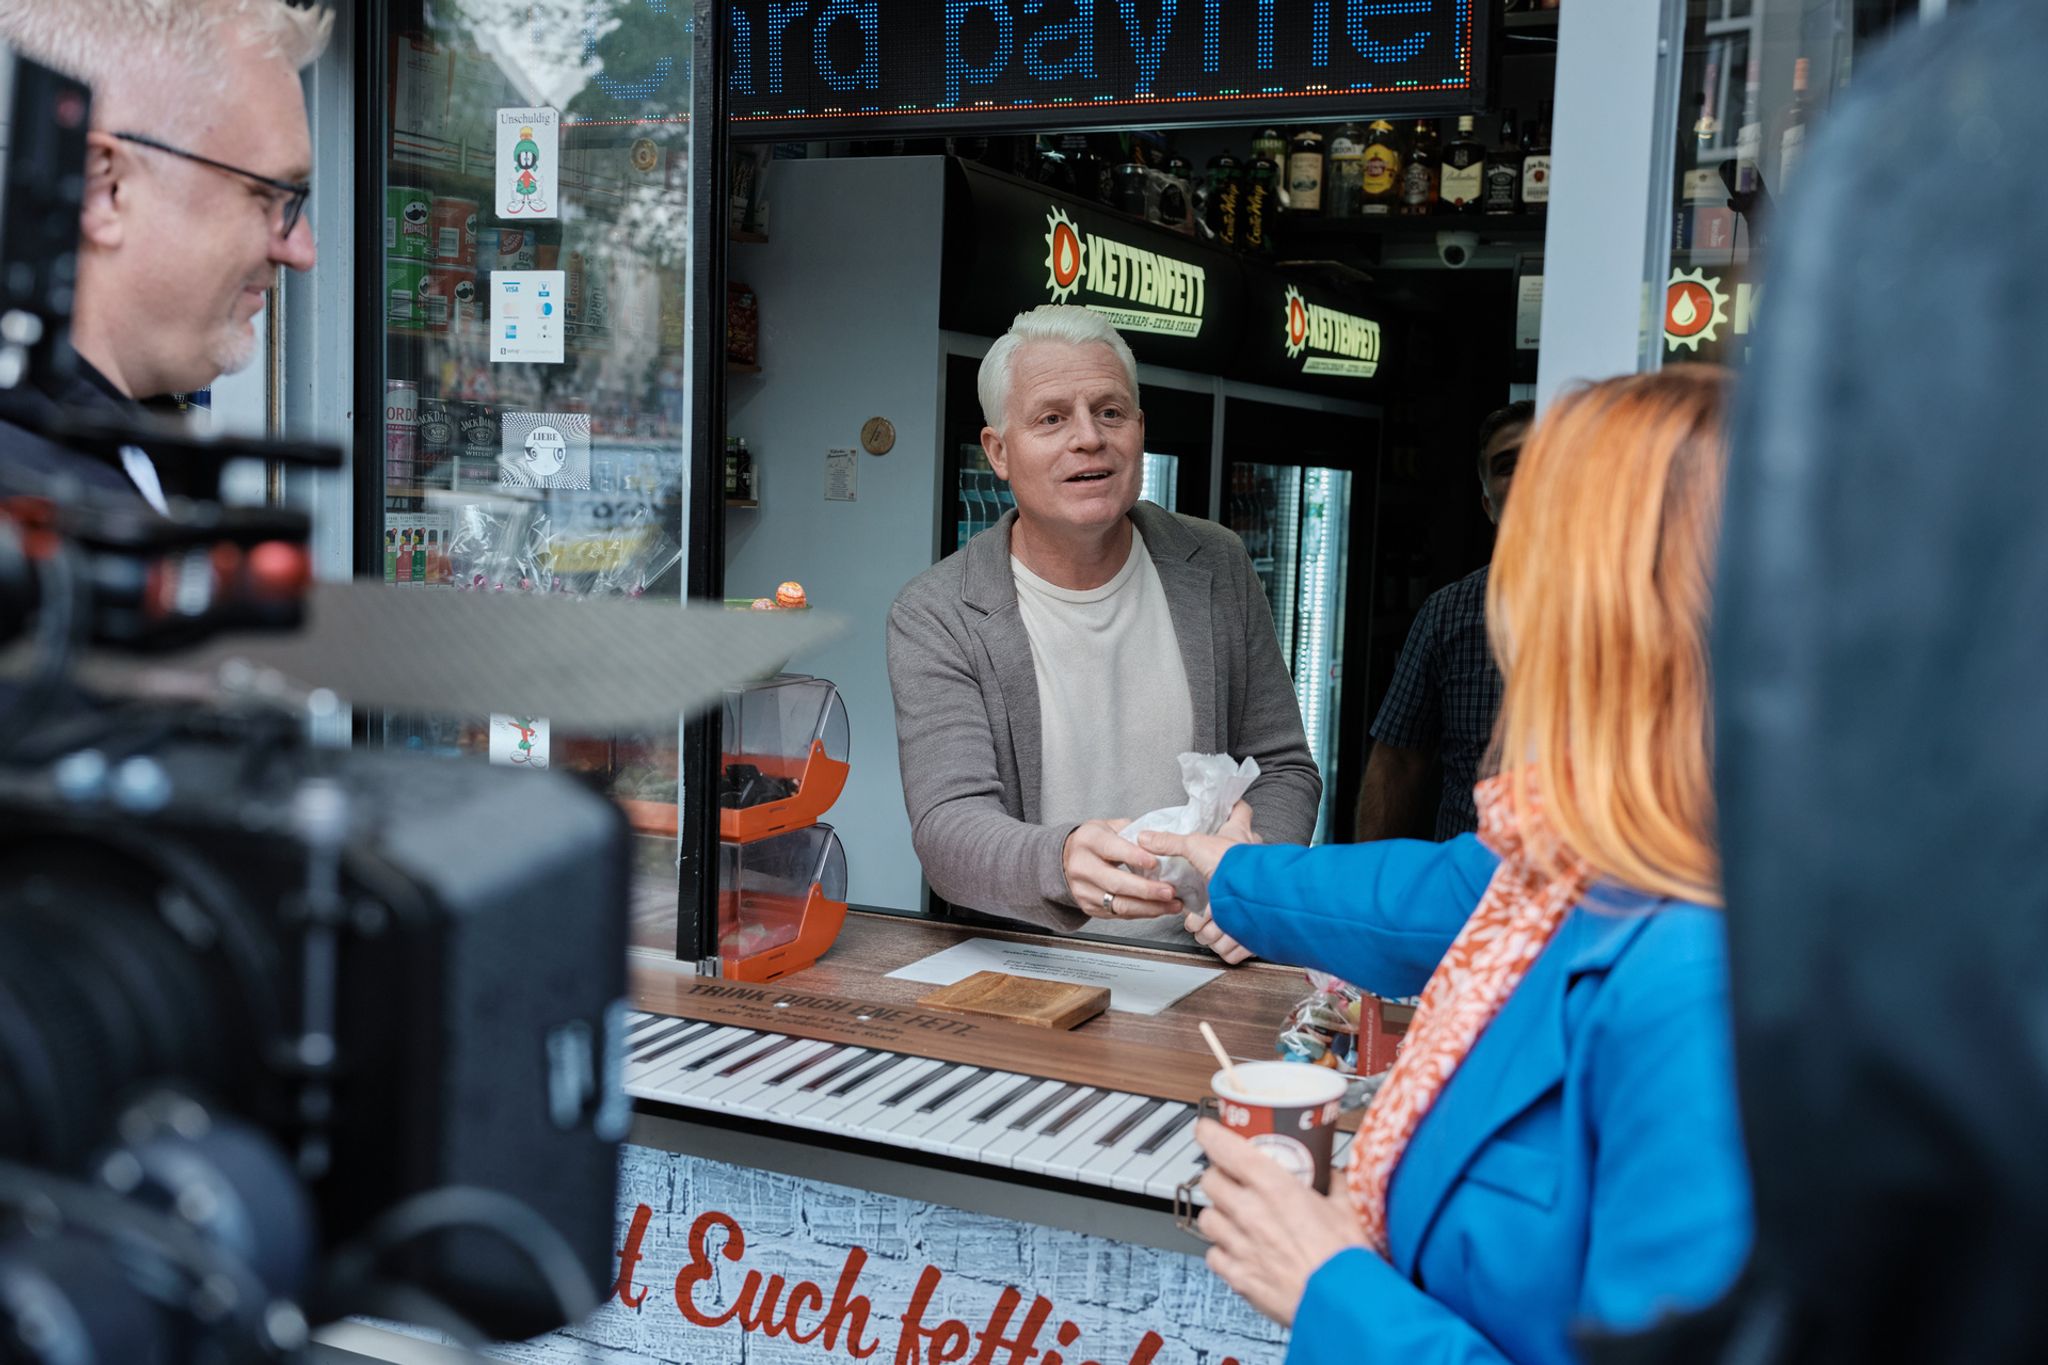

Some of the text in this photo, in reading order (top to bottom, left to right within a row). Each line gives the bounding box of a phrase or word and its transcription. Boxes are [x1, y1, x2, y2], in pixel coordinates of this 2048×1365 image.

[501, 113, 550, 125] Unschuldig
[1086, 233, 1206, 317] KETTENFETT
[1308, 303, 1380, 362] KETTENFETT
[533, 432, 559, 442] LIEBE
[687, 983, 778, 1003] TRINK
[772, 993, 852, 1013] DOCH
[850, 1004, 908, 1023] ENE
[675, 1210, 880, 1359] Euch
